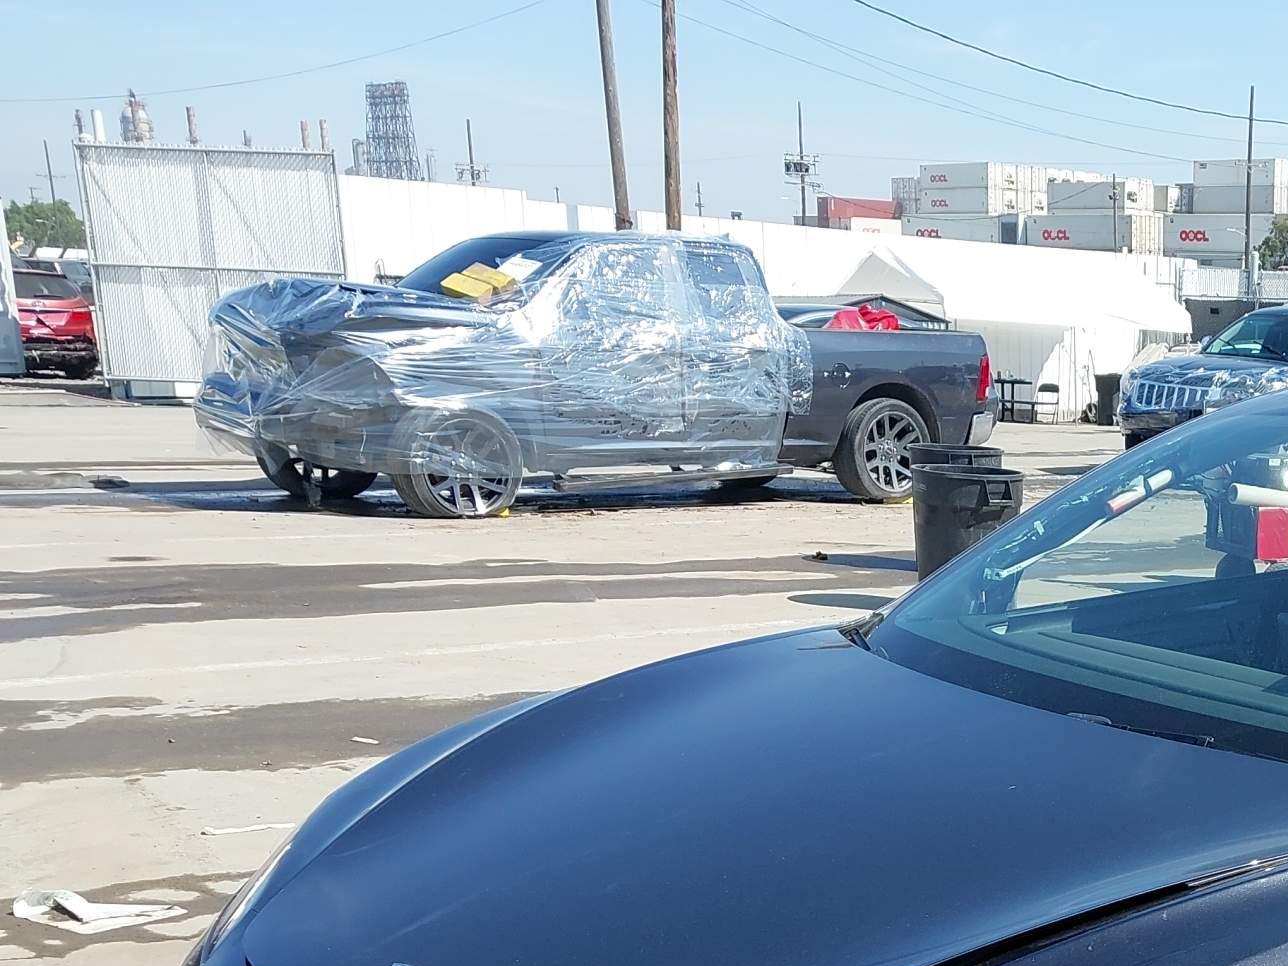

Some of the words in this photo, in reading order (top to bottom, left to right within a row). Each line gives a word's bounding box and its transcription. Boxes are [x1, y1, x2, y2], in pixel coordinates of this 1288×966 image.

[930, 174, 947, 182] OOCL
[931, 199, 948, 207] OOCL
[1179, 230, 1209, 242] OOCL
